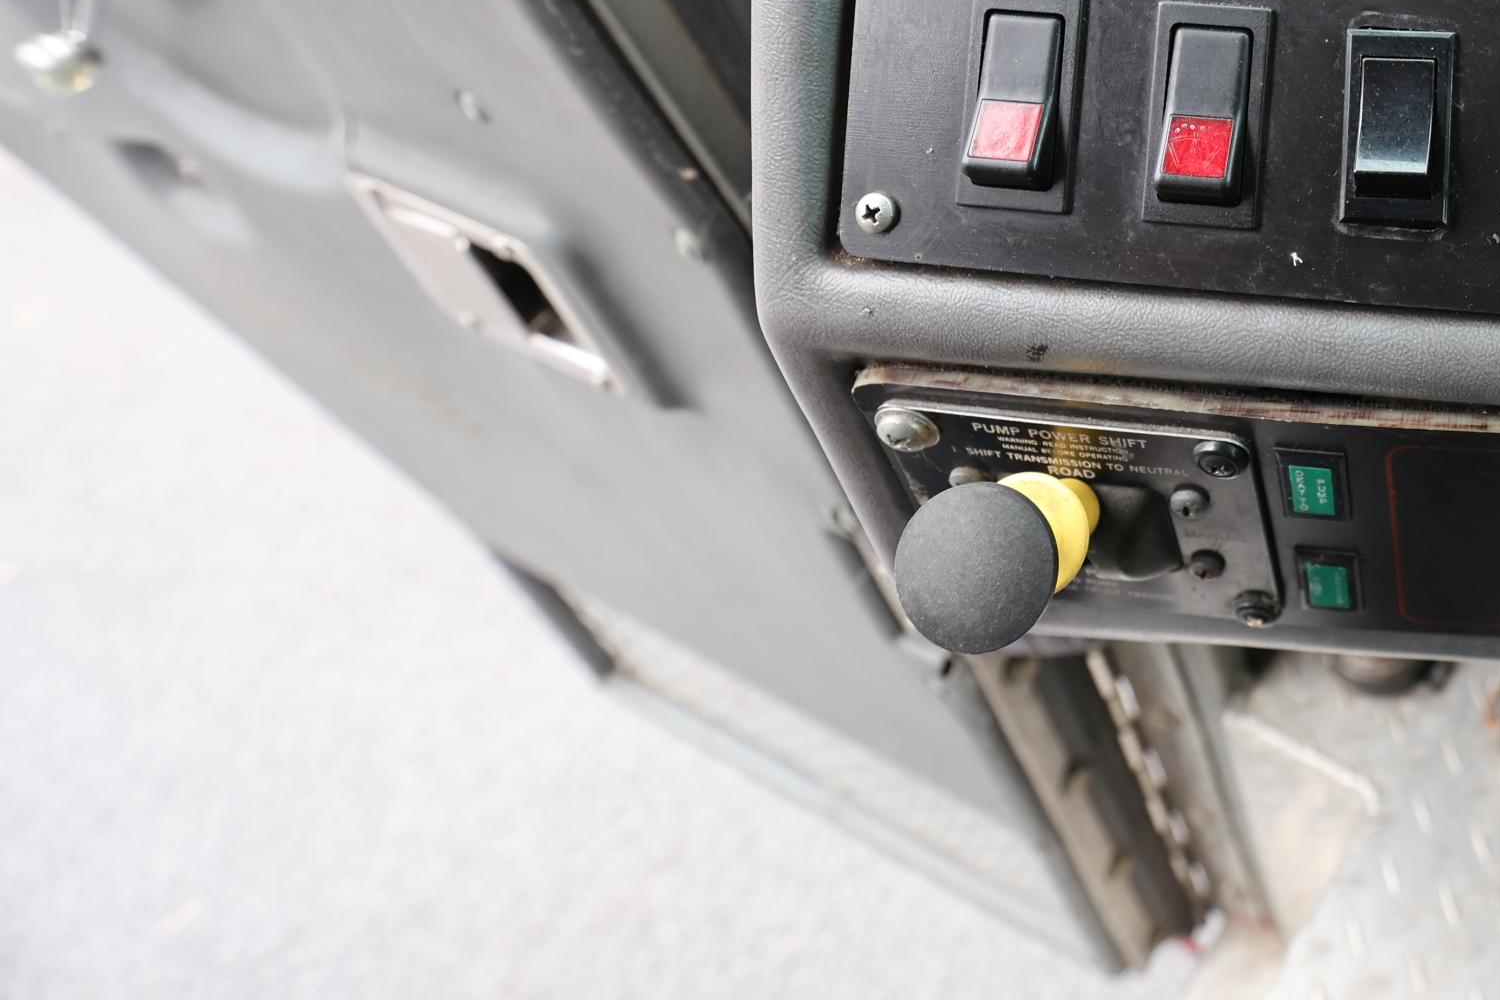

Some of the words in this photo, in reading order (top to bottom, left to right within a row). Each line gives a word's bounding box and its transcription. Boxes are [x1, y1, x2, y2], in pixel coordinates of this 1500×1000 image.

[971, 422, 1020, 436] PUMP
[1027, 428, 1091, 443] POWER
[1098, 436, 1148, 449] SHIFT
[997, 436, 1038, 446] WARNING
[1042, 440, 1066, 449] READ
[965, 447, 1001, 459] SHIFT
[1006, 452, 1102, 470] TRANSMISSION
[1106, 463, 1124, 472] TO
[1129, 465, 1190, 477] NEUTRAL
[1002, 444, 1039, 453] MANUAL
[1041, 448, 1076, 457] BEORE
[1079, 452, 1129, 462] OPERATING
[1047, 465, 1096, 479] ROAD
